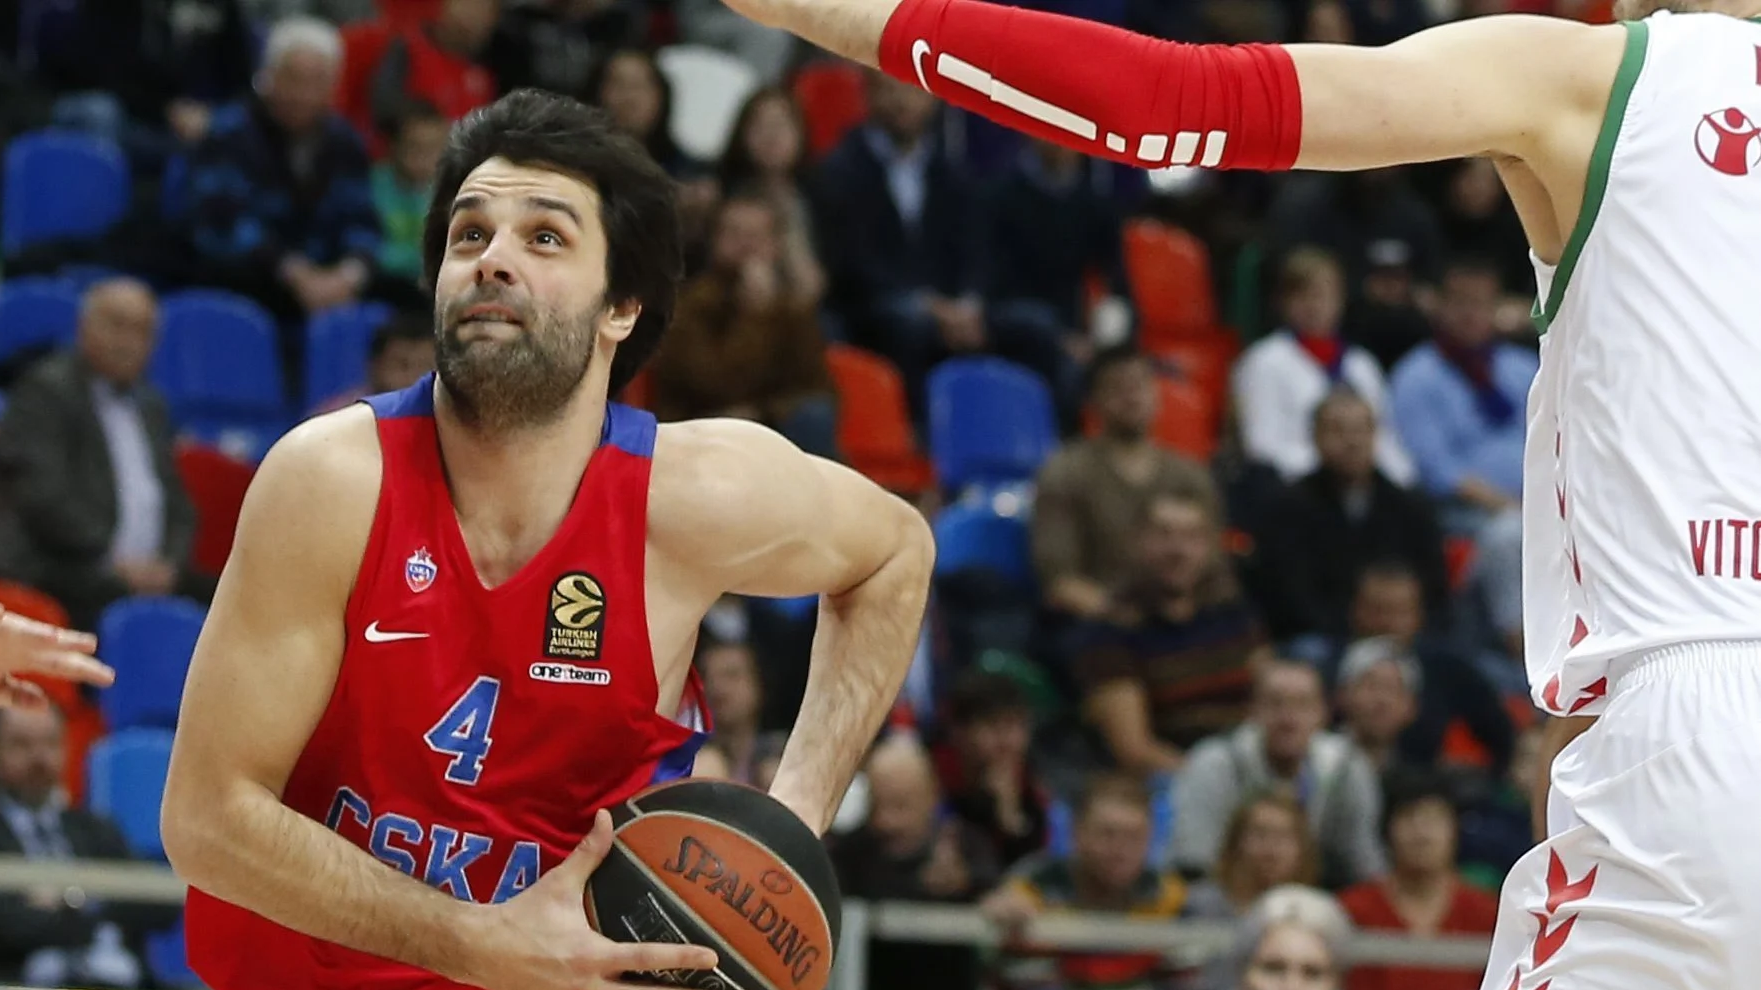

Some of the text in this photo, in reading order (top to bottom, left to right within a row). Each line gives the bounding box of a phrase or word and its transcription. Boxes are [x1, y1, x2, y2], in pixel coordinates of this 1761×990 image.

[550, 637, 597, 649] AIRLINES
[551, 627, 598, 640] TURKISH
[423, 675, 501, 786] 4
[663, 835, 822, 987] SPALDING
